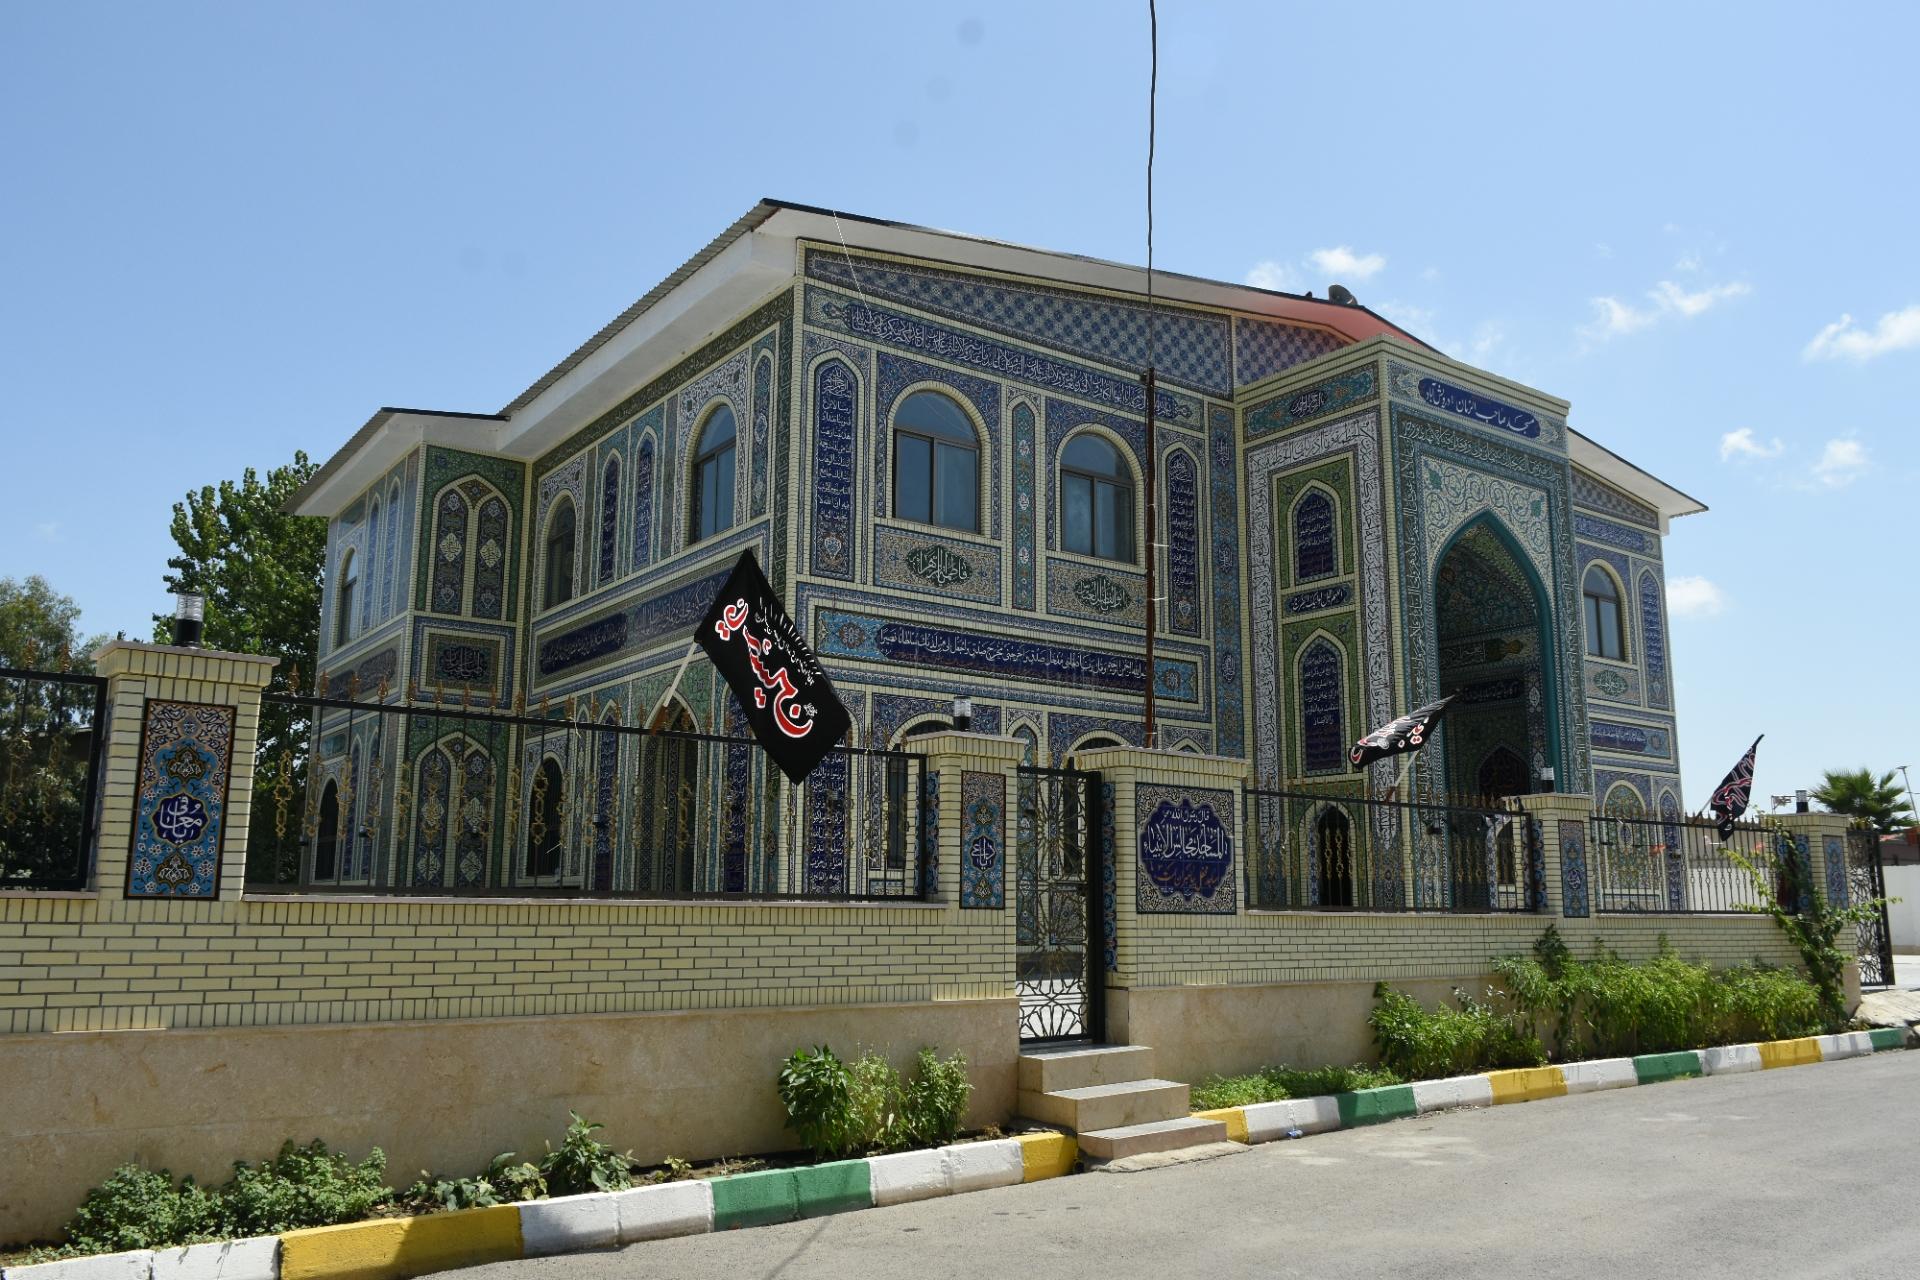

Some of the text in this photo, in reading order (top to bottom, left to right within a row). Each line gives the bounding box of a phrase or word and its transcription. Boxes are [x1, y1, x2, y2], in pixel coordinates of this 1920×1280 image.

[1455, 394, 1477, 417] الزمان
[1474, 399, 1506, 427] صاحب
[1507, 410, 1534, 436] مسجد
[1172, 809, 1183, 820] الله
[1183, 810, 1198, 823] رسول
[1198, 811, 1210, 823] قال
[1191, 824, 1224, 860] المساجد
